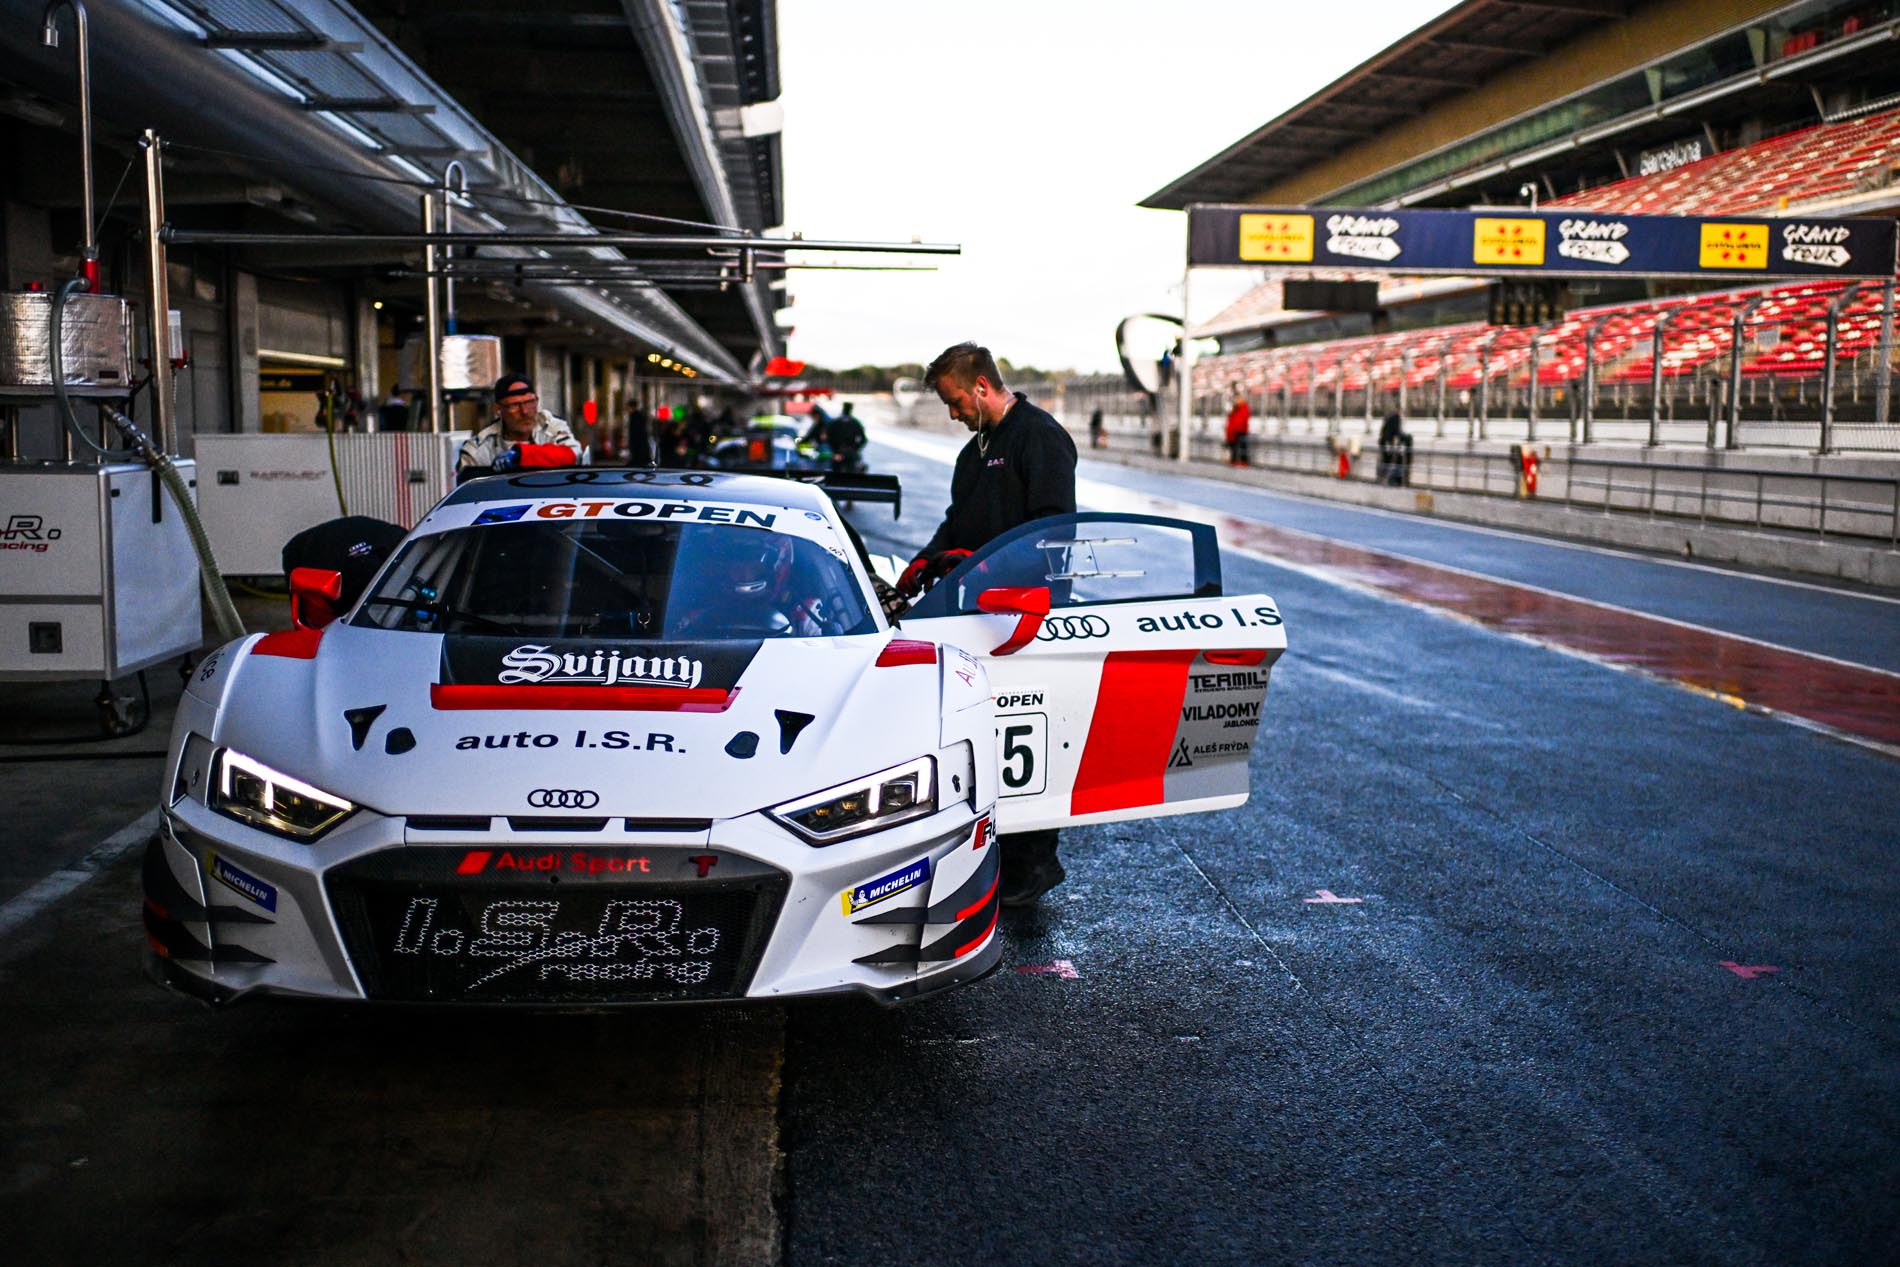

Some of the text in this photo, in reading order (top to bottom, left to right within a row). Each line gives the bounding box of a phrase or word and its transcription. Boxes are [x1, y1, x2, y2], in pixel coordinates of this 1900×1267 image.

[1326, 214, 1399, 236] GRAND
[1558, 219, 1629, 240] GRAND
[1783, 224, 1850, 245] GRAND
[1790, 244, 1839, 263] TOUR
[1136, 611, 1223, 633] auto
[498, 644, 702, 689] Svijany
[992, 693, 1044, 708] OPEN
[1182, 702, 1260, 721] VILADOMY
[1223, 719, 1260, 729] JABLONEC
[455, 730, 687, 754] auto I.S.R.
[1193, 740, 1249, 754] ALEŠ FRÝDA
[995, 725, 1034, 788] 5
[495, 850, 651, 876] Audi Sport
[223, 869, 268, 901] MICHELIN
[869, 868, 922, 899] MICHELIN
